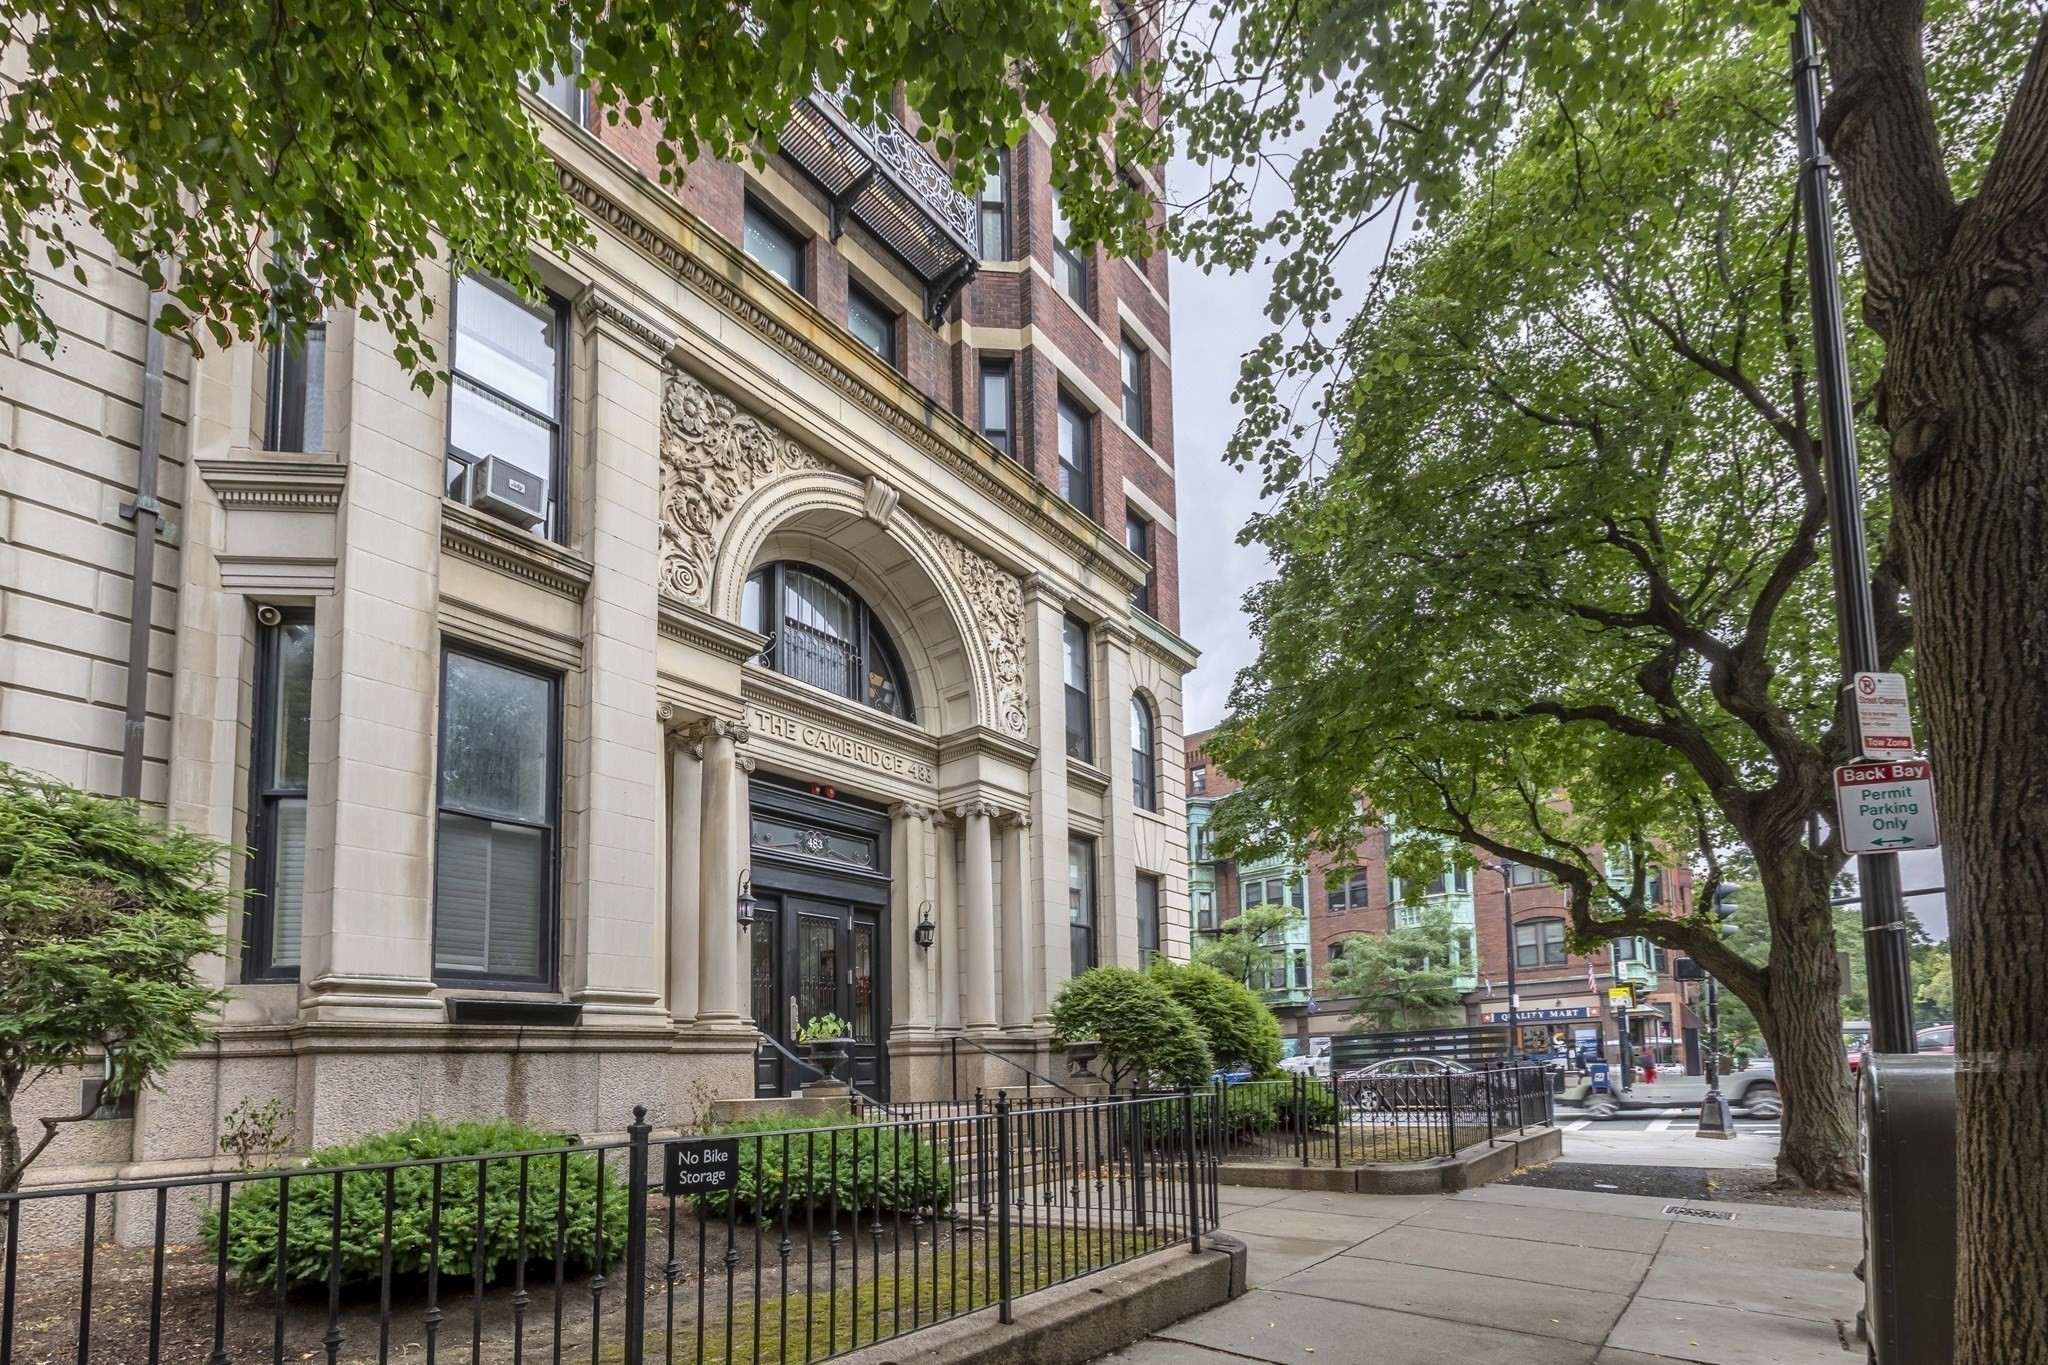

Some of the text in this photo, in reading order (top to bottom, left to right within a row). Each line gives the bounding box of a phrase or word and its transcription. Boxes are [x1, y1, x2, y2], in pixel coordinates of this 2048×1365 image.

[1858, 696, 1906, 707] Street Cleaning
[755, 711, 797, 741] THE
[1867, 737, 1908, 747] Tow Zone
[1843, 765, 1924, 782] Back Bay
[1861, 786, 1912, 801] Permit
[1859, 801, 1918, 816] Parking
[1872, 817, 1908, 831] Only
[807, 838, 823, 849] 483
[1501, 1009, 1578, 1021] QALITY MART
[678, 1149, 729, 1166] No Bike
[679, 1170, 726, 1185] Storage
